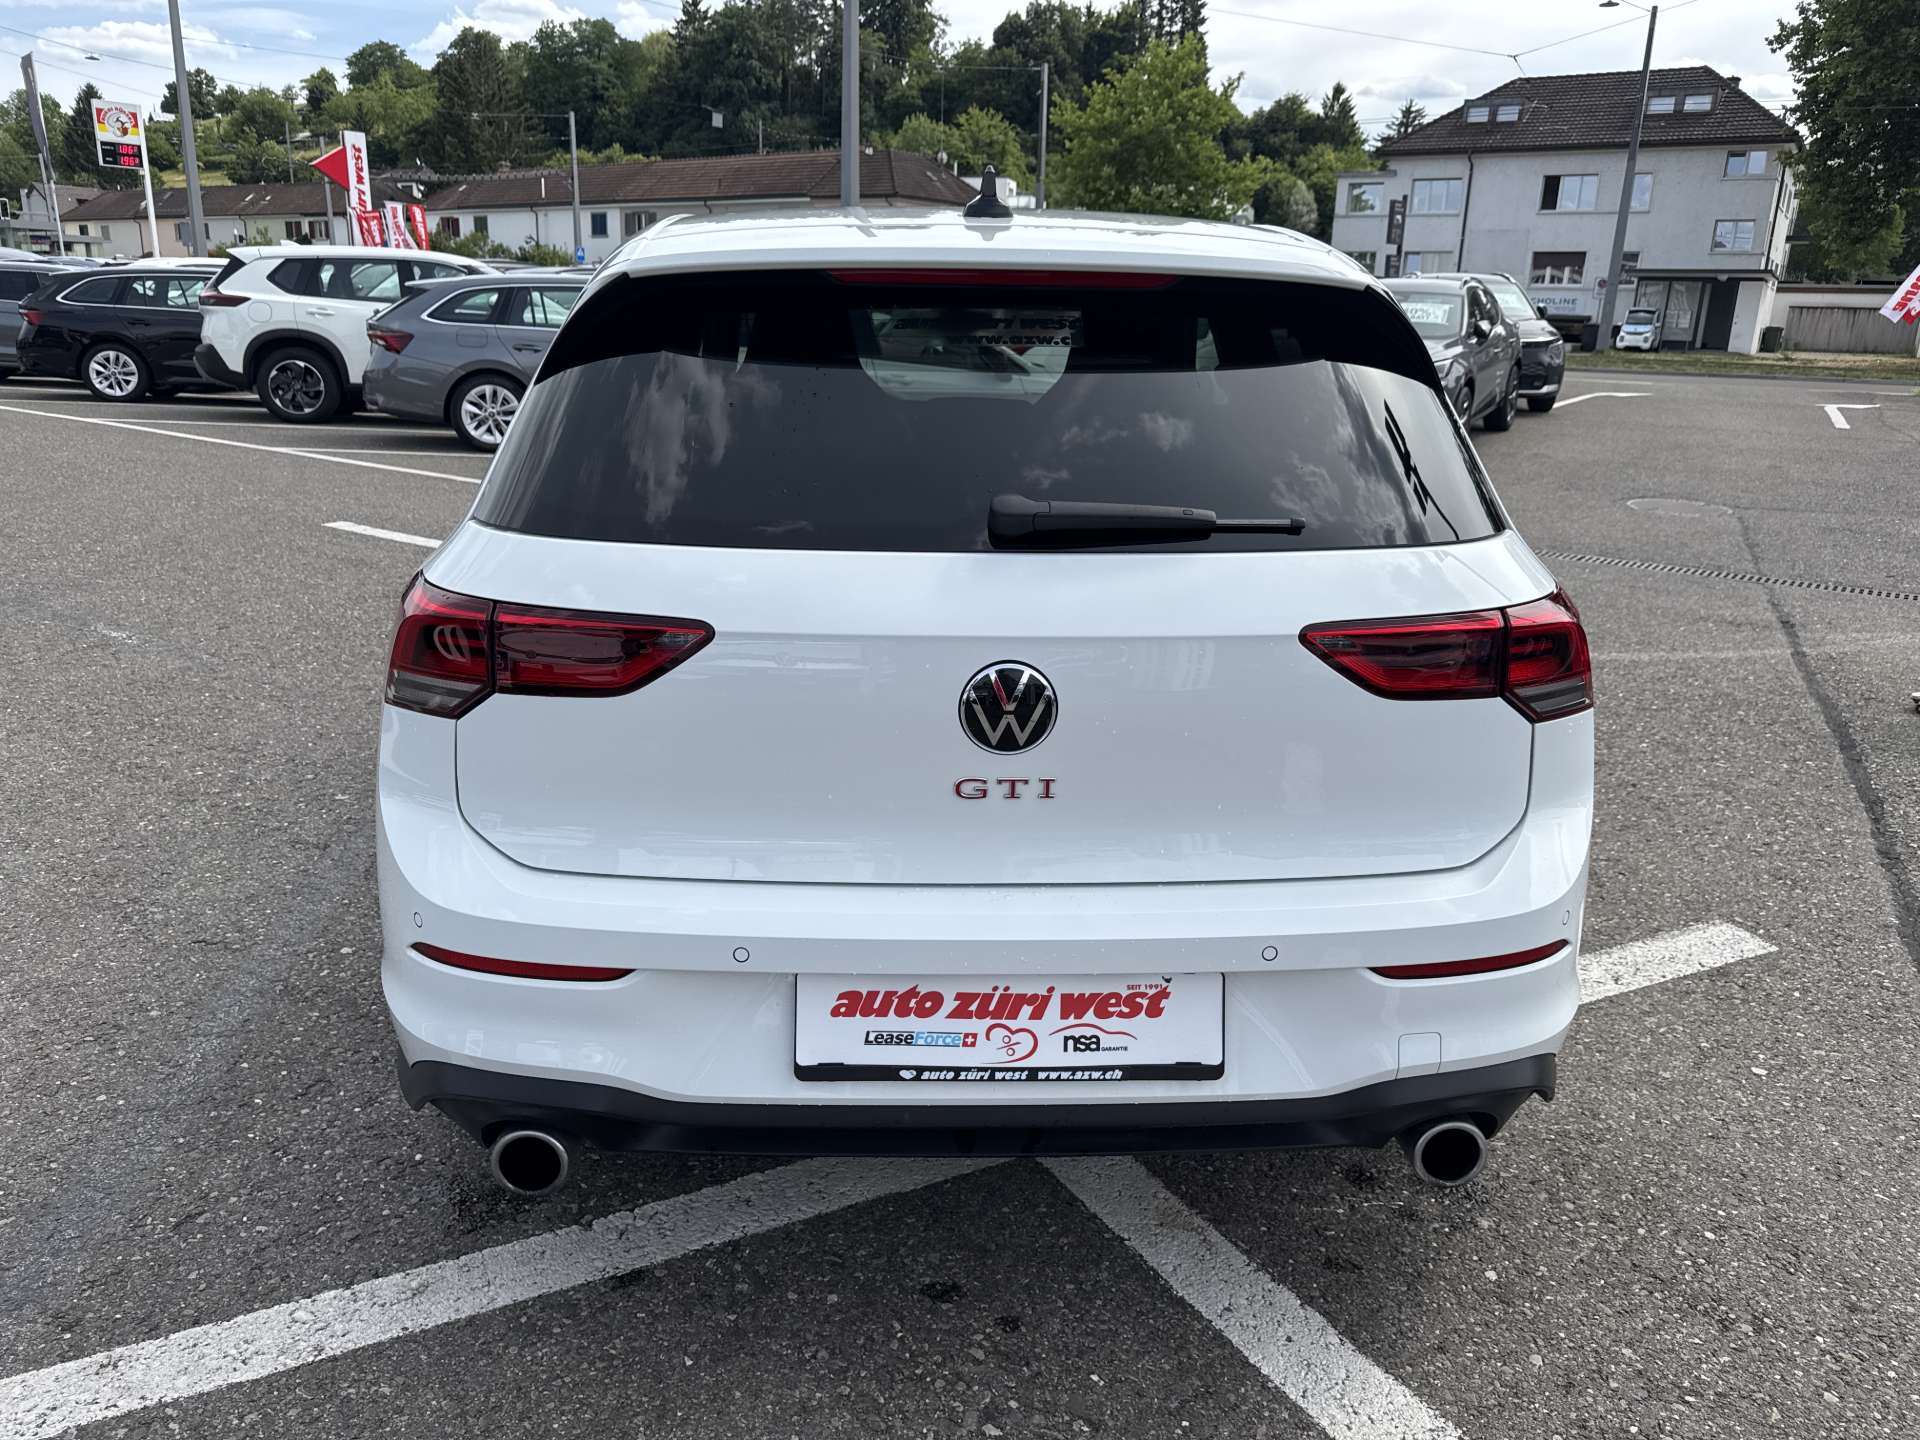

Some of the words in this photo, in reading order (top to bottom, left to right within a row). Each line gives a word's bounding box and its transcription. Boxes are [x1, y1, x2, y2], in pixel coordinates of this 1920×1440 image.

[954, 776, 1056, 799] GTI
[1144, 983, 1163, 991] 1991
[830, 984, 944, 1019] auto
[945, 985, 1056, 1021] züri
[1059, 985, 1172, 1020] west
[864, 1031, 962, 1047] LeaseForce
[1063, 1035, 1100, 1053] nsa
[920, 1070, 954, 1080] auto
[958, 1068, 991, 1080] züri
[994, 1070, 1028, 1080] west
[1037, 1069, 1123, 1080] www.azw.ch
